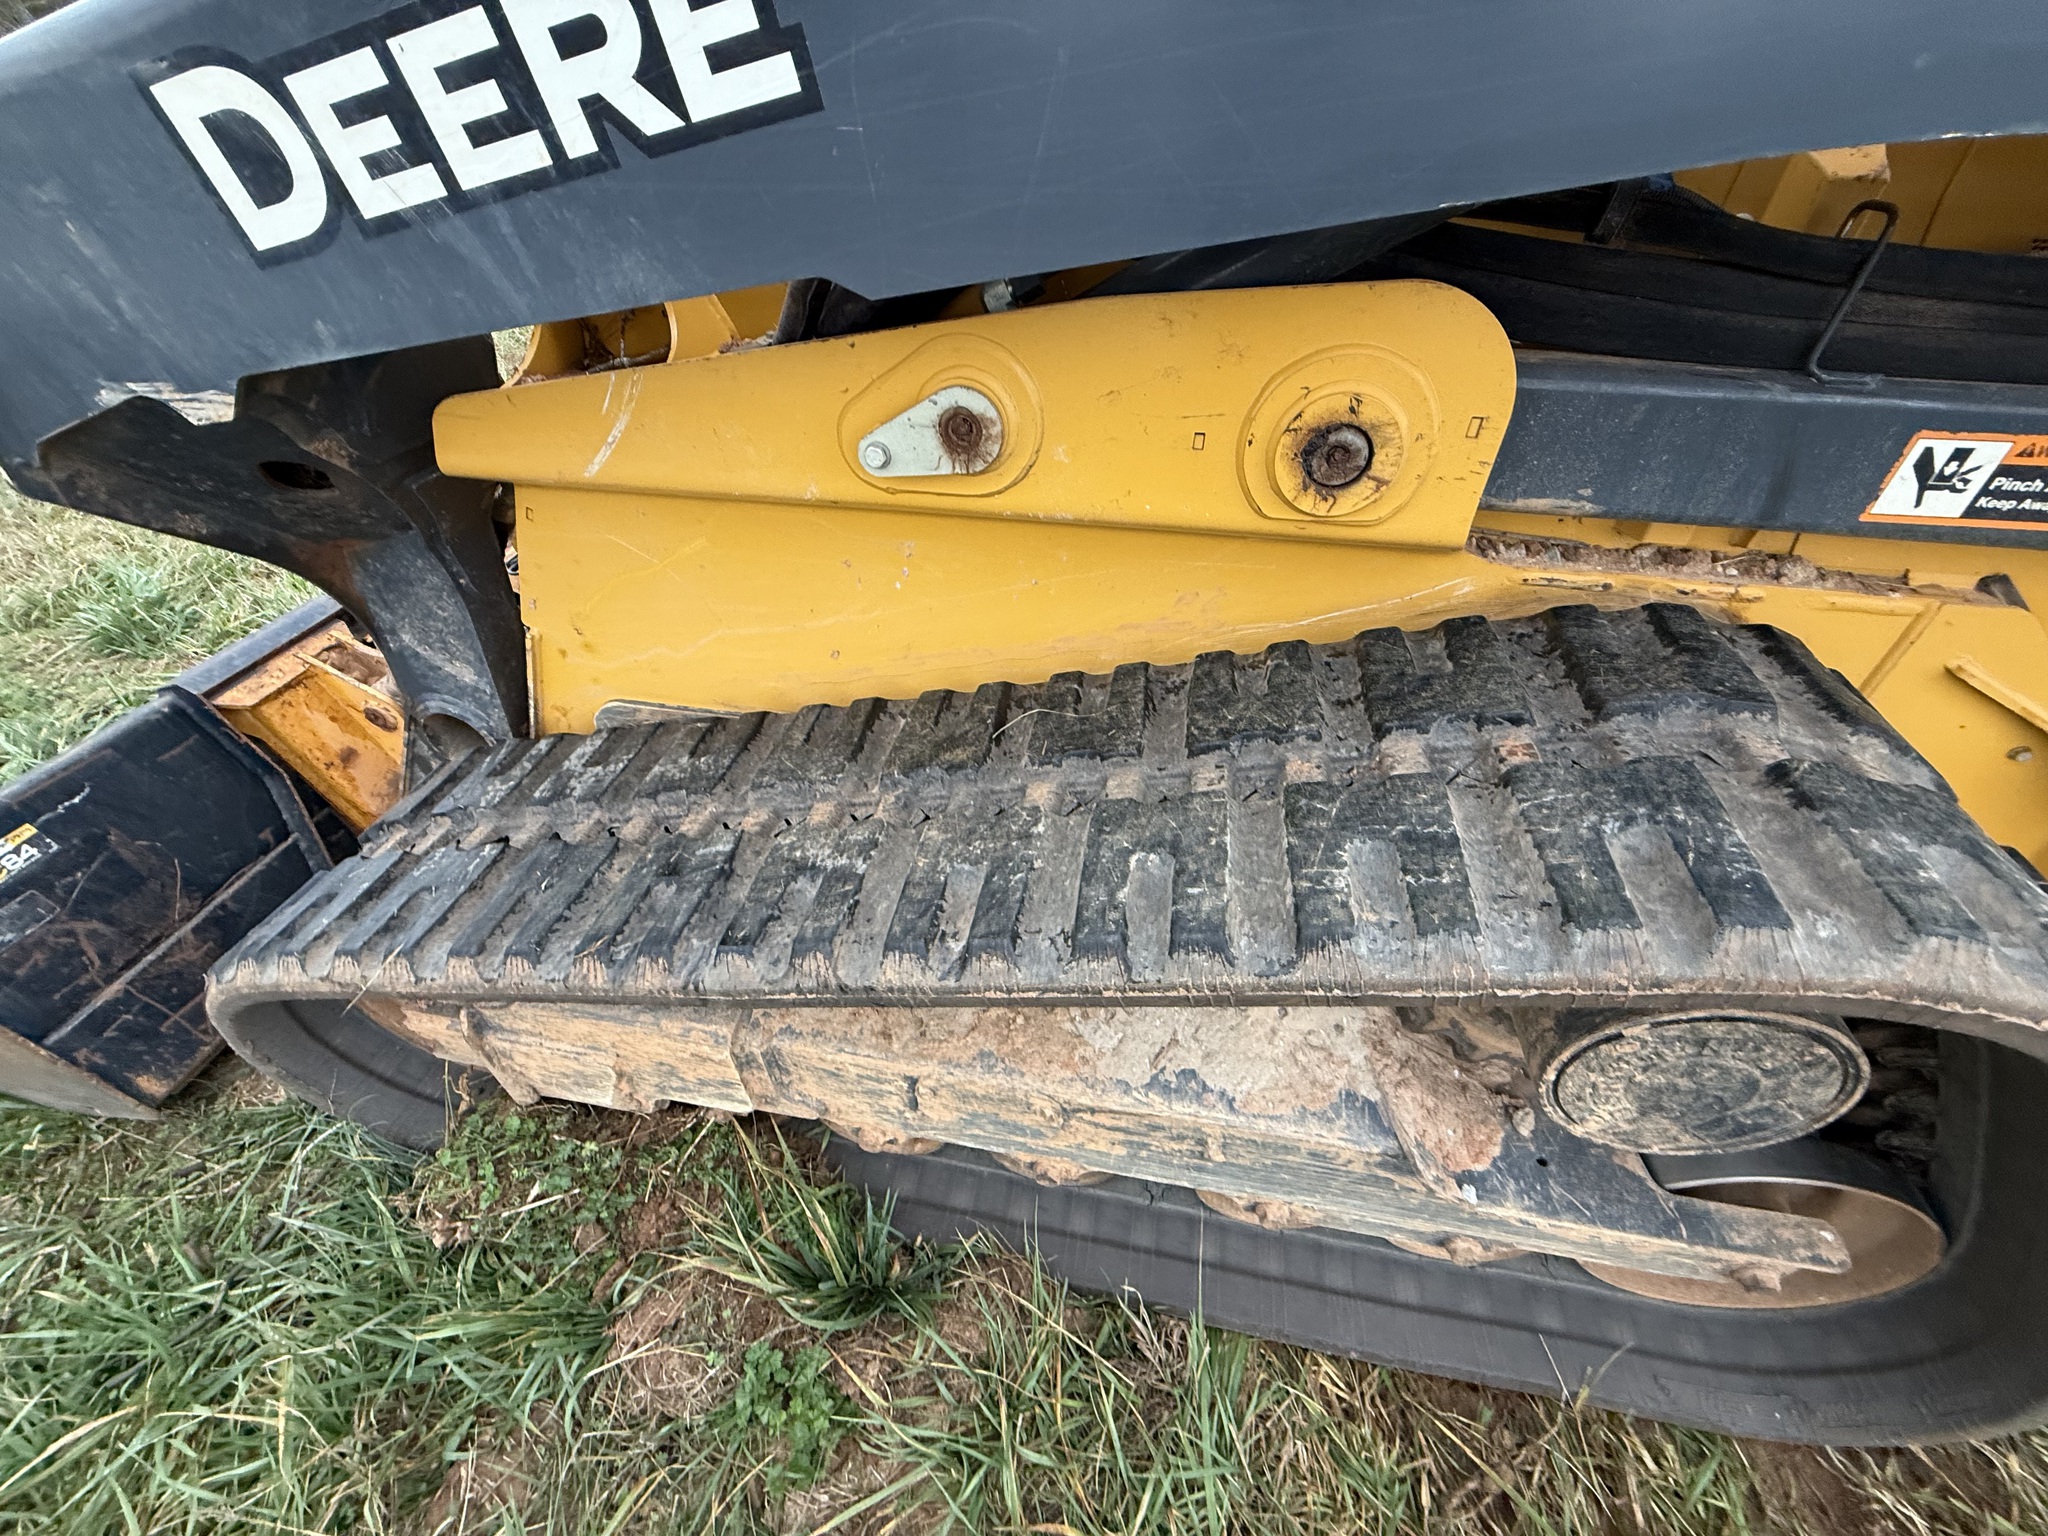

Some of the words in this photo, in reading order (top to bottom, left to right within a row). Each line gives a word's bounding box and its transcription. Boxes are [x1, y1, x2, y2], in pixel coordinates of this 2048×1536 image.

[149, 0, 802, 251] DEERE
[1989, 477, 2045, 492] Pinch
[1975, 496, 2018, 511] Keep
[2017, 498, 2048, 514] Awa
